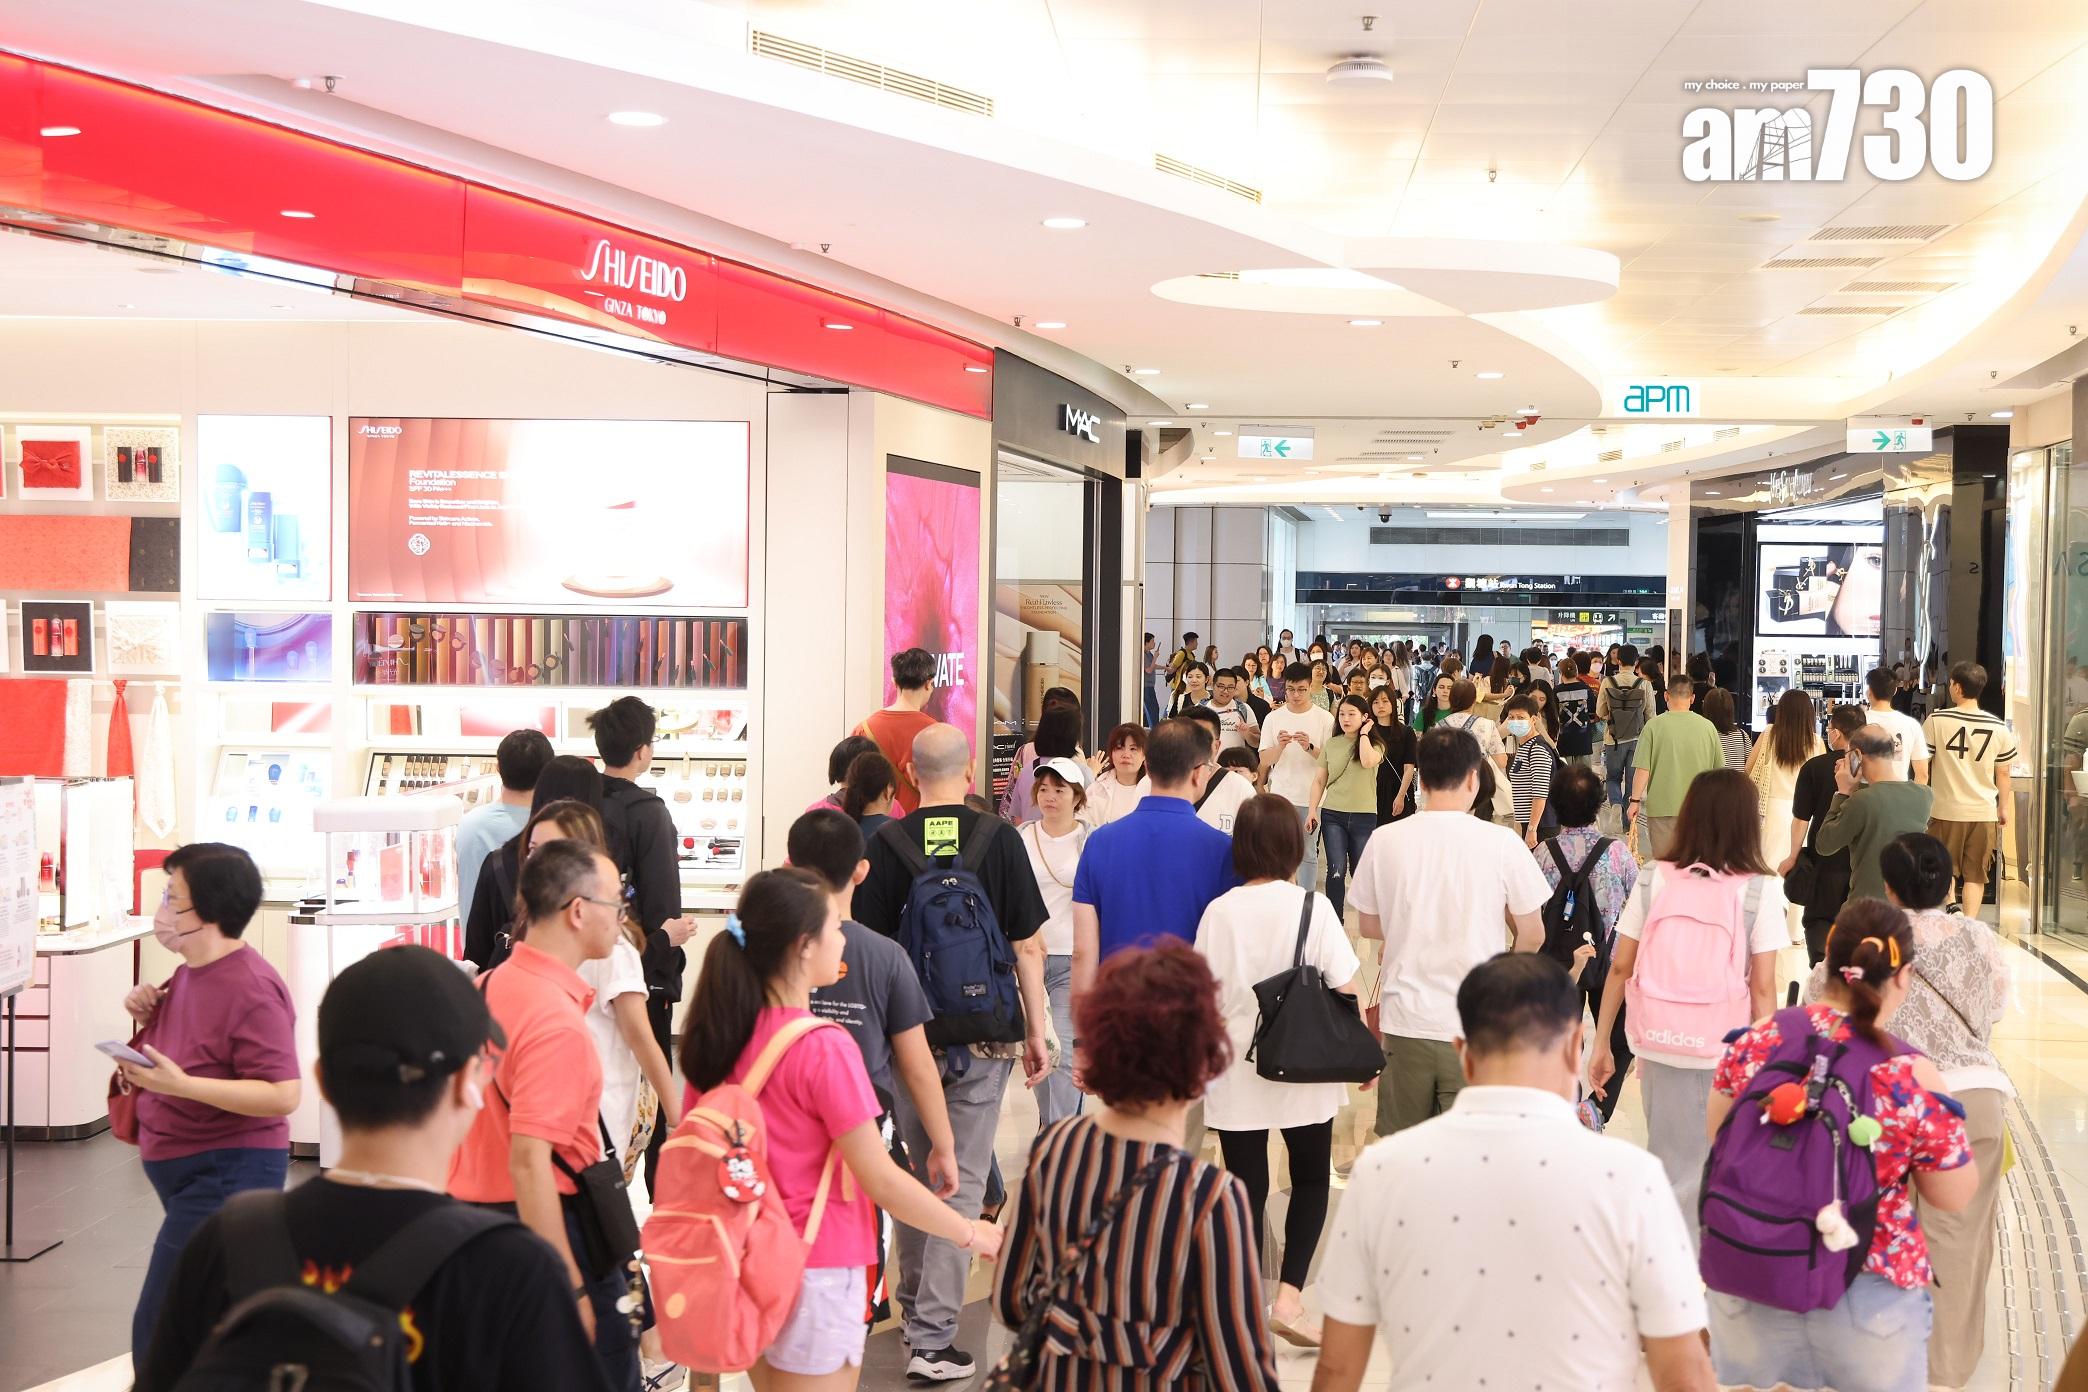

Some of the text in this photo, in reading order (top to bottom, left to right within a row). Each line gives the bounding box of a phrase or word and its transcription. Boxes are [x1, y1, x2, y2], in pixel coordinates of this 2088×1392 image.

[580, 239, 687, 302] SHISEIDO
[604, 297, 667, 326] GINZA TOKYO
[1065, 403, 1101, 444] MAC
[1518, 582, 1533, 590] Tong
[1534, 582, 1556, 590] Station
[1945, 726, 1993, 762] 47
[1646, 1029, 1705, 1048] adidas
